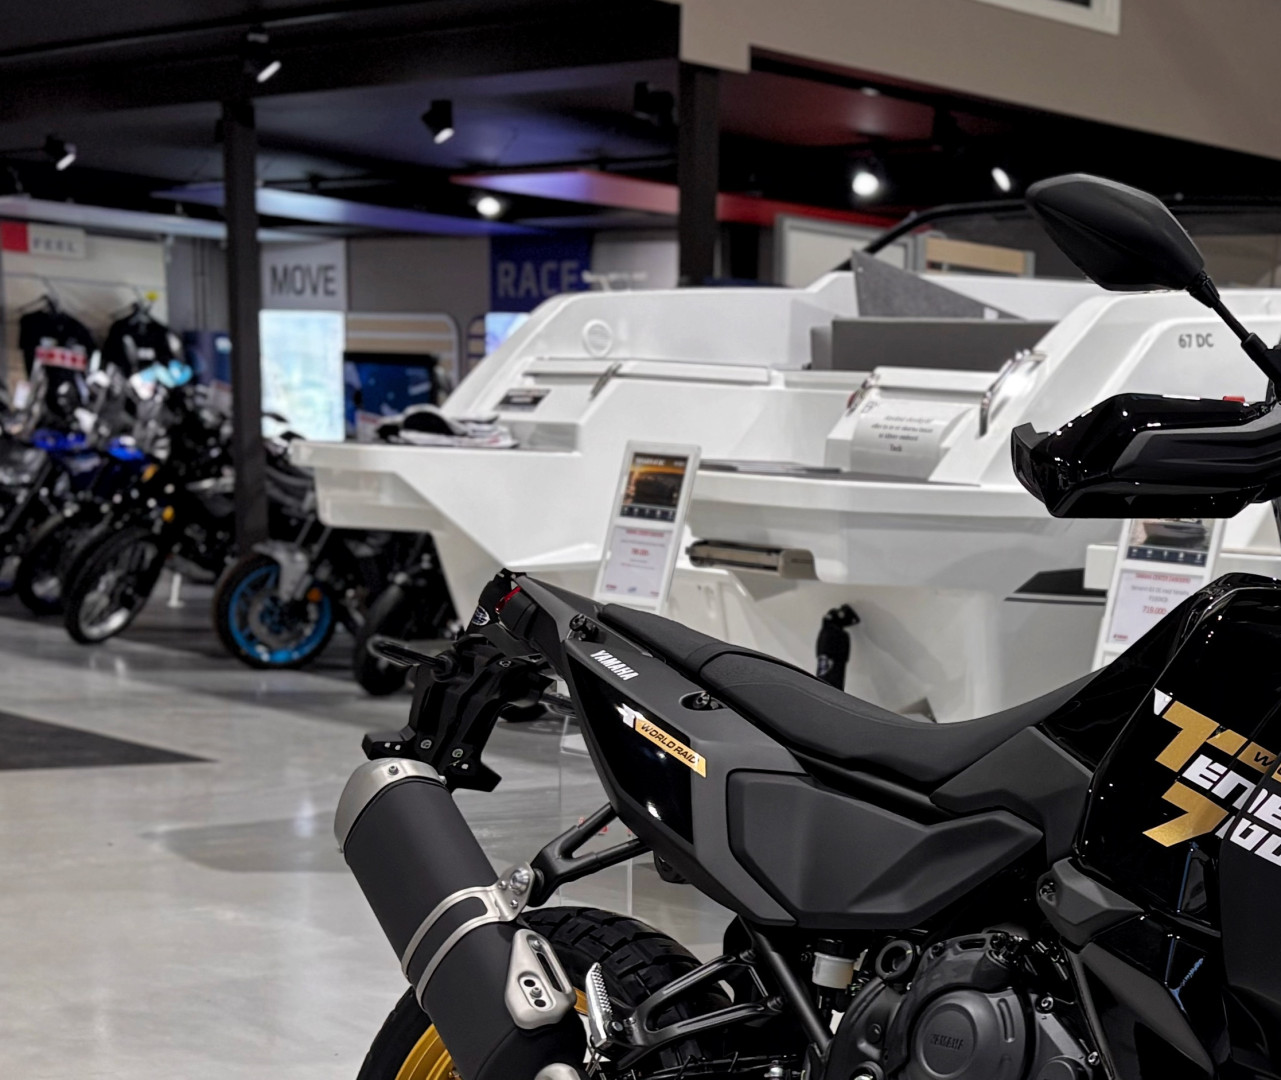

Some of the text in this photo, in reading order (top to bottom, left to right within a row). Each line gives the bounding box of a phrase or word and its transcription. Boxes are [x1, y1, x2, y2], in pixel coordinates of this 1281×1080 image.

[270, 264, 337, 297] MOVE
[497, 260, 580, 298] RACE
[1178, 333, 1214, 349] 67 DC
[590, 649, 639, 681] YAMAHA
[640, 722, 700, 764] WORLD RAID
